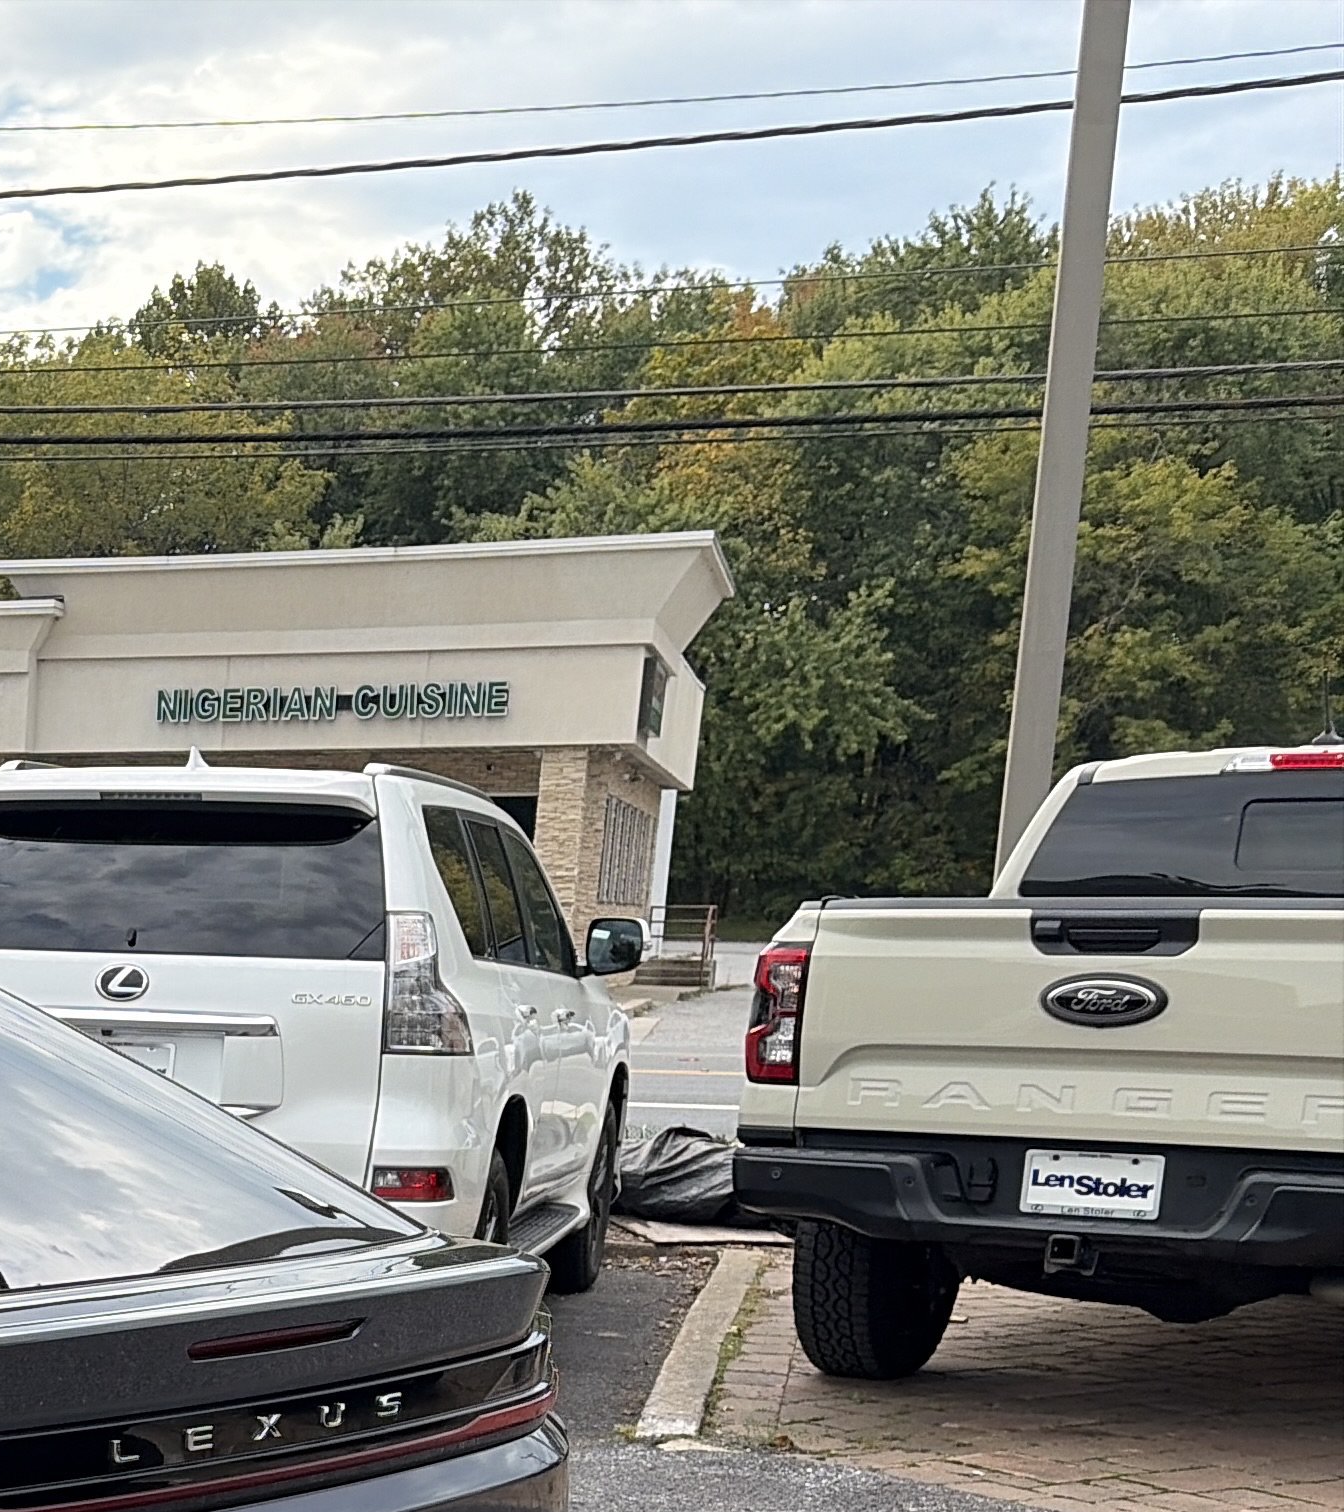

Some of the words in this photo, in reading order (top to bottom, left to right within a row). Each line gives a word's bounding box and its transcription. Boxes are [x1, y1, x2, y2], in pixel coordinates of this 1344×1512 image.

[155, 685, 337, 723] NIGERIAN
[351, 681, 510, 719] CUISINE
[1071, 988, 1131, 1012] Ford
[111, 1392, 402, 1464] LEXUS
